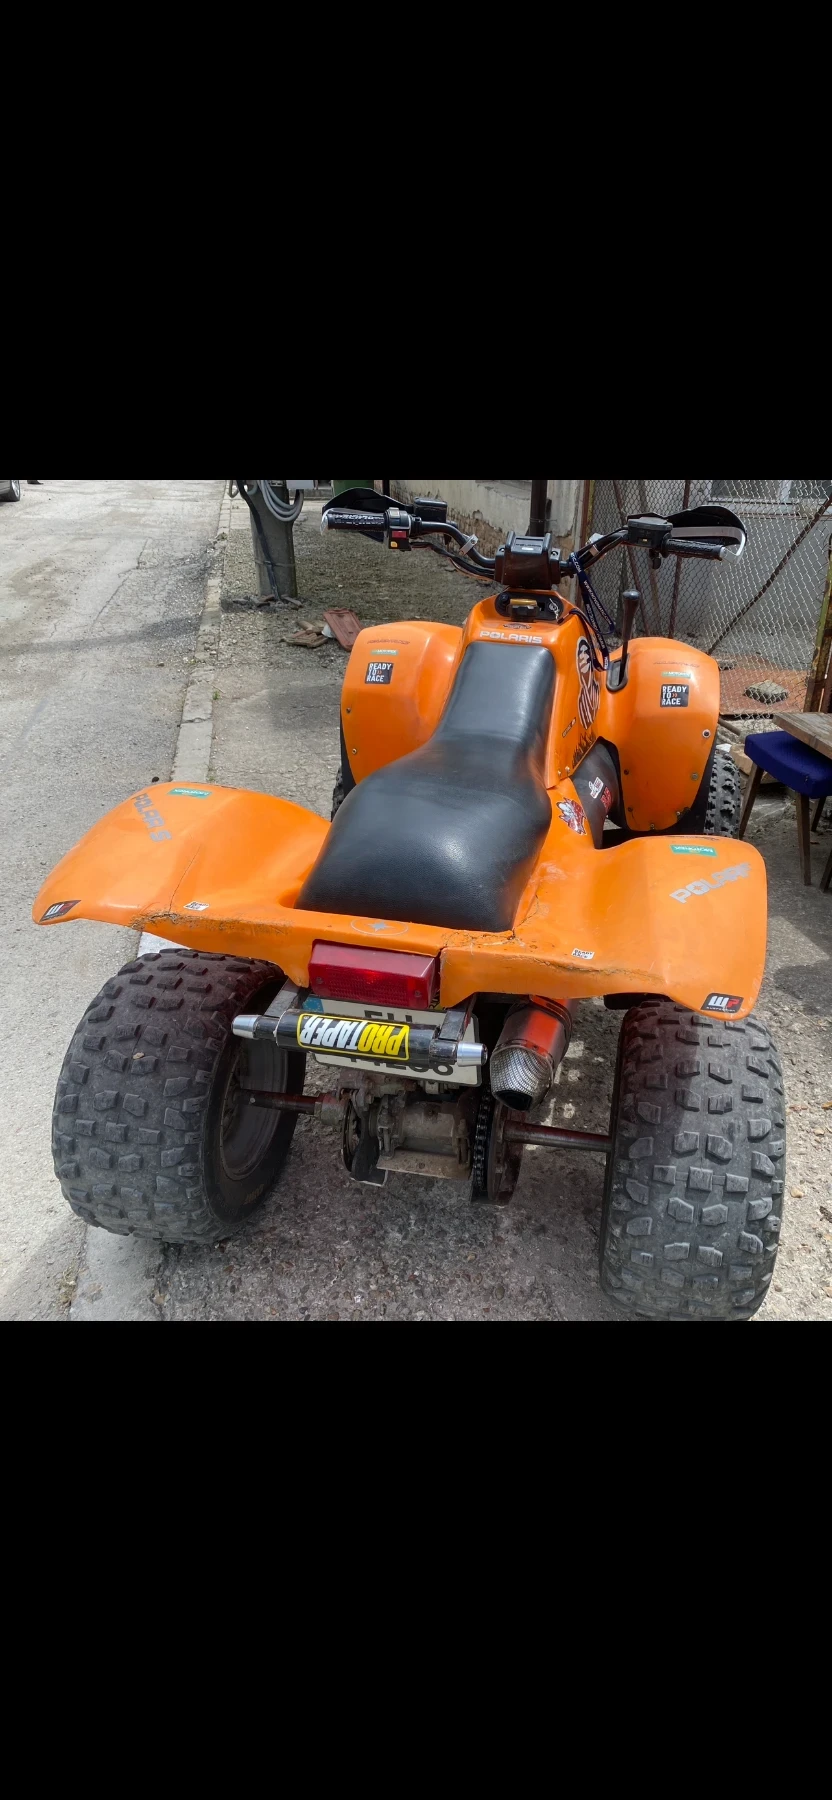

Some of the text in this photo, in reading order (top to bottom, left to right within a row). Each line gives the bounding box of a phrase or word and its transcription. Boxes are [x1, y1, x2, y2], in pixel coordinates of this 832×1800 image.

[479, 630, 543, 644] POLARIS
[369, 663, 392, 671] READY
[366, 675, 385, 683] RACE
[661, 698, 682, 706] RACE
[708, 995, 740, 1008] WP
